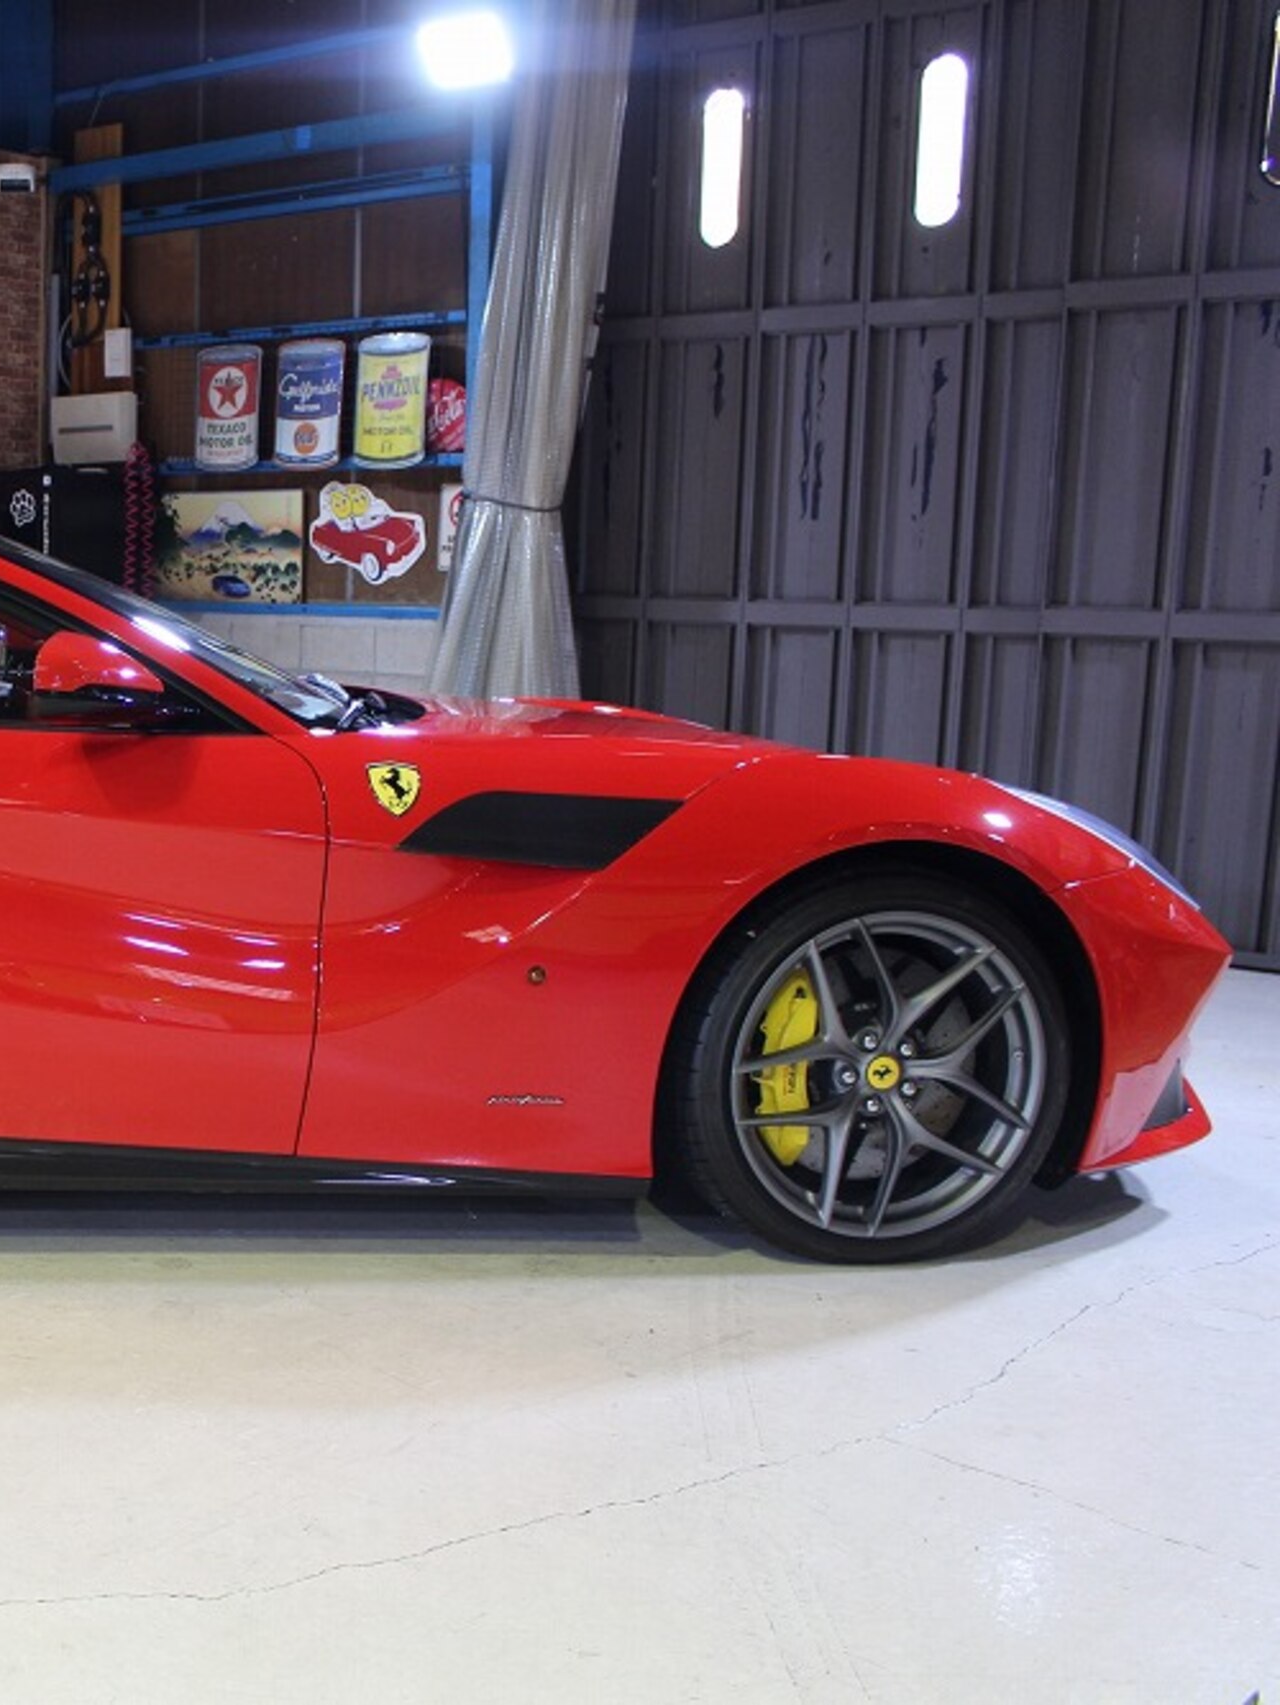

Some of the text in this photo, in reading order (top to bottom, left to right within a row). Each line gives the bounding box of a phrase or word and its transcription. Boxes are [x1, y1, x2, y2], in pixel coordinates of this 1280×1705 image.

[206, 422, 247, 434] TEXACO
[363, 426, 397, 436] MOTOR
[199, 434, 254, 449] MOTOR OIL
